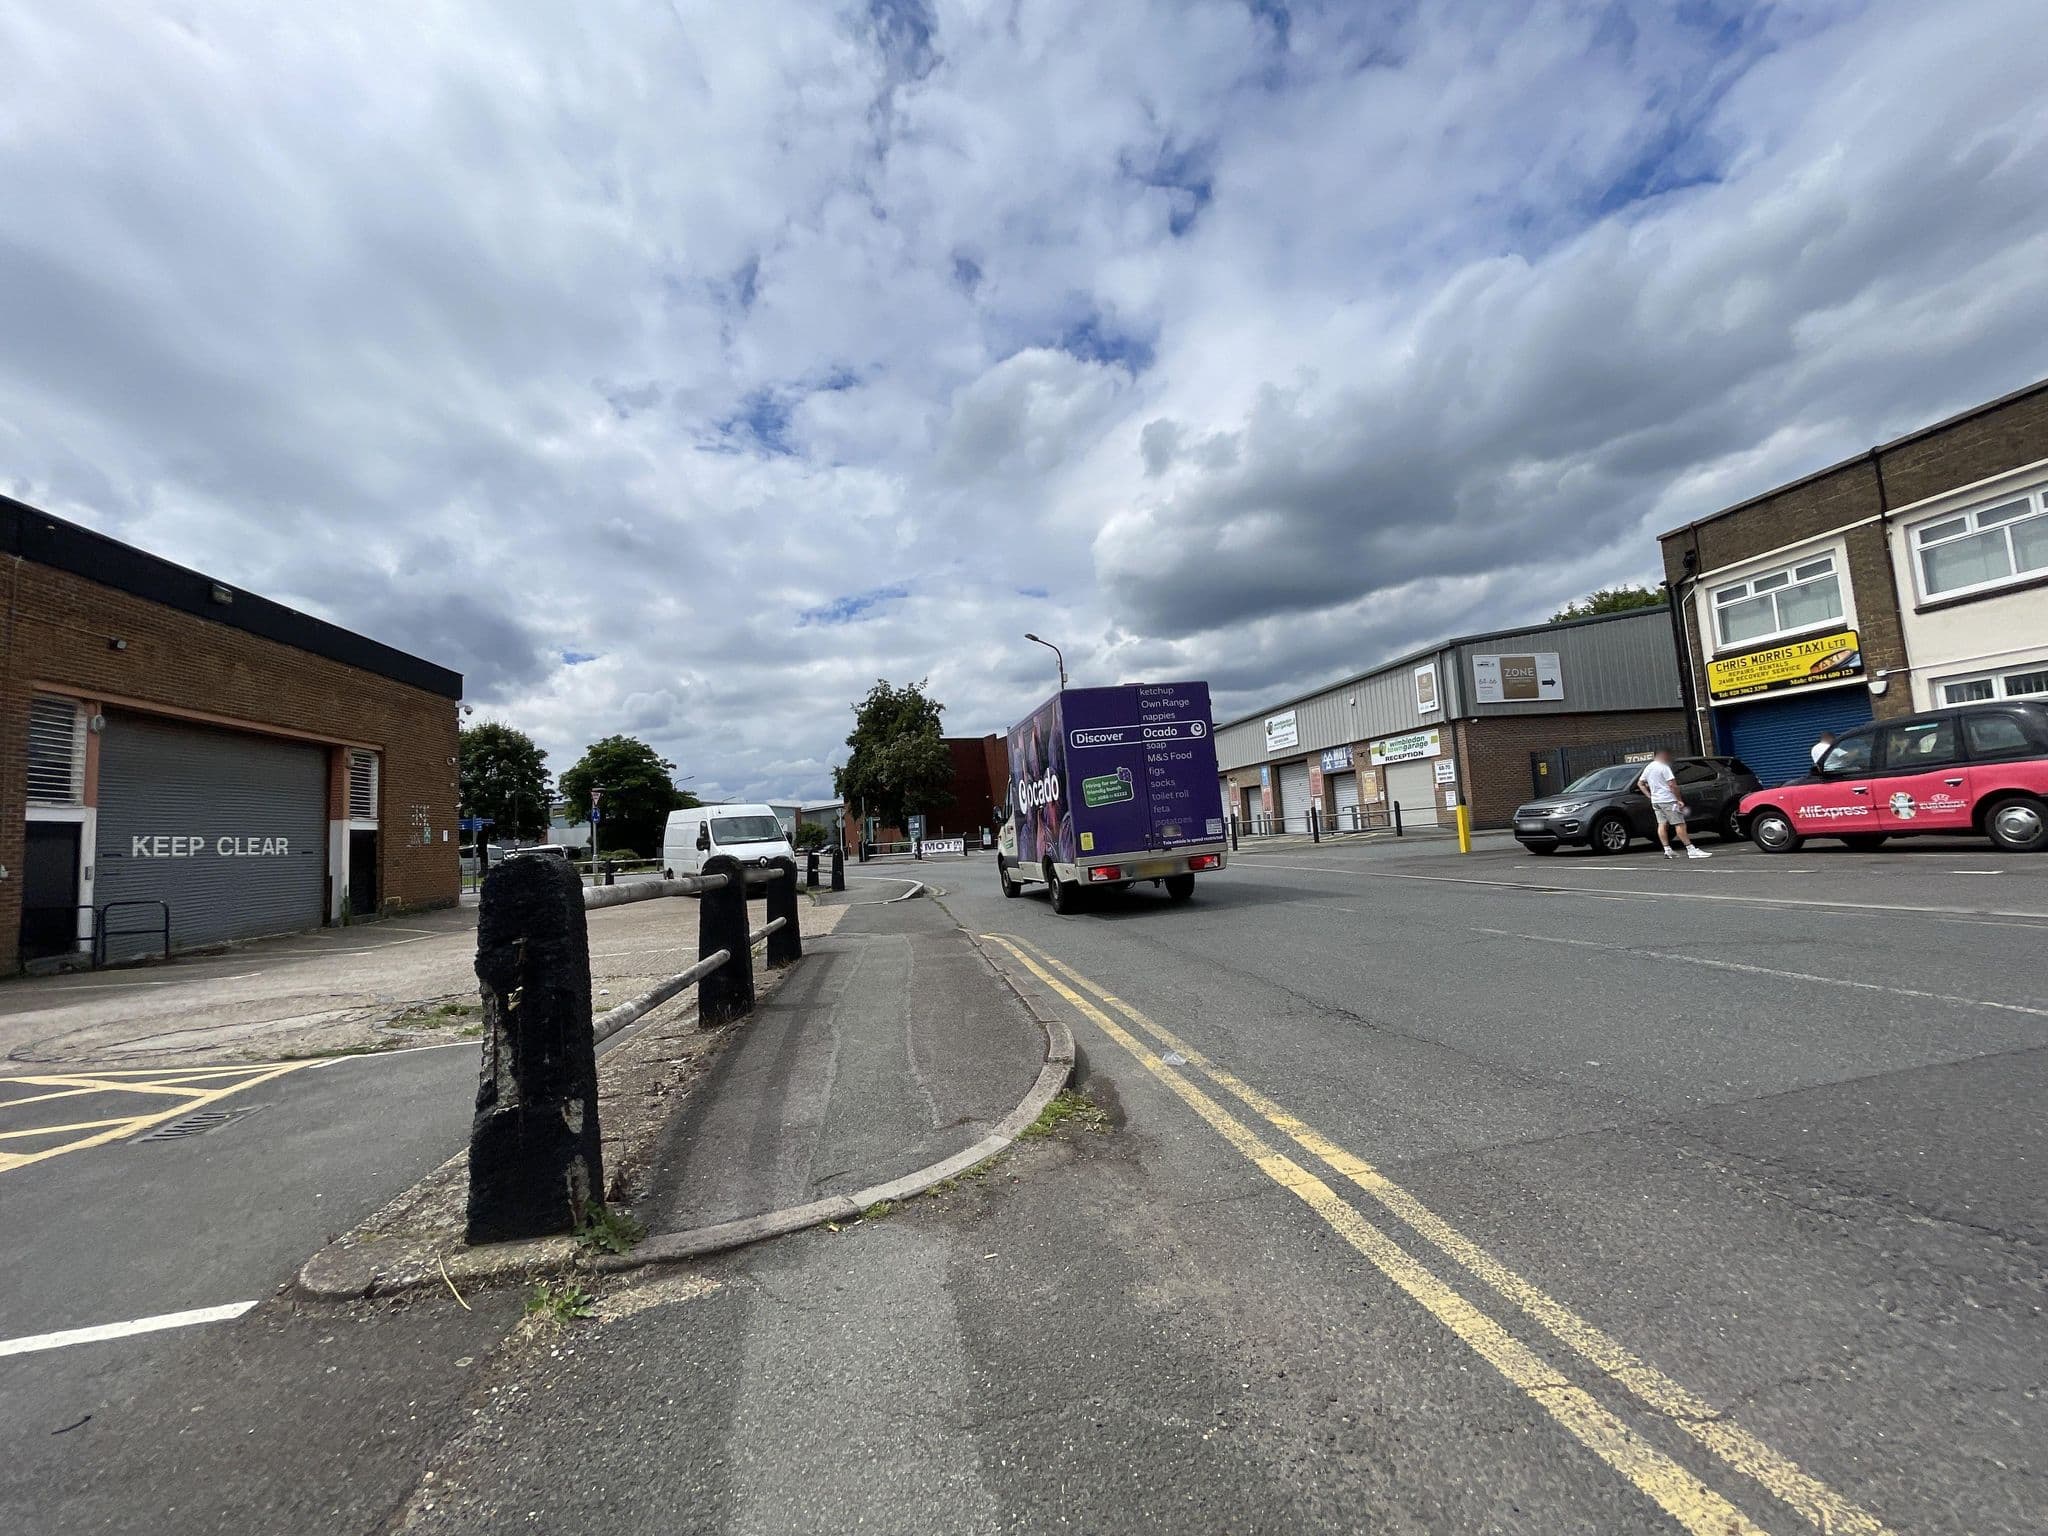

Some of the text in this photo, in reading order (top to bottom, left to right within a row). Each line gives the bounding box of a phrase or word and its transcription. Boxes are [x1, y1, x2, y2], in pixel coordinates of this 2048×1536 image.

[1716, 639, 1846, 672] CHRIS MORRIS TAXI LTD
[1503, 667, 1535, 677] ZONE
[1736, 670, 1769, 682] RECOVERY
[1772, 664, 1801, 675] SERVICE
[1140, 687, 1174, 696] ketchup
[1141, 699, 1190, 708] Own Range
[1143, 712, 1175, 721] nappies
[1076, 726, 1177, 744] Discover Ocado
[1146, 742, 1167, 750] soap
[1389, 735, 1425, 748] wimbledon
[1147, 750, 1192, 762] M&S Food
[1385, 750, 1424, 761] RECEPTION
[1149, 766, 1165, 776] figs
[1027, 768, 1059, 808] ocado
[1151, 778, 1175, 788] socks
[1152, 789, 1189, 801] toilet roll
[1154, 804, 1170, 814] feta
[1799, 805, 1869, 819] AliExpress
[132, 835, 289, 857] KEEP CLEAR
[924, 841, 952, 851] MOT
